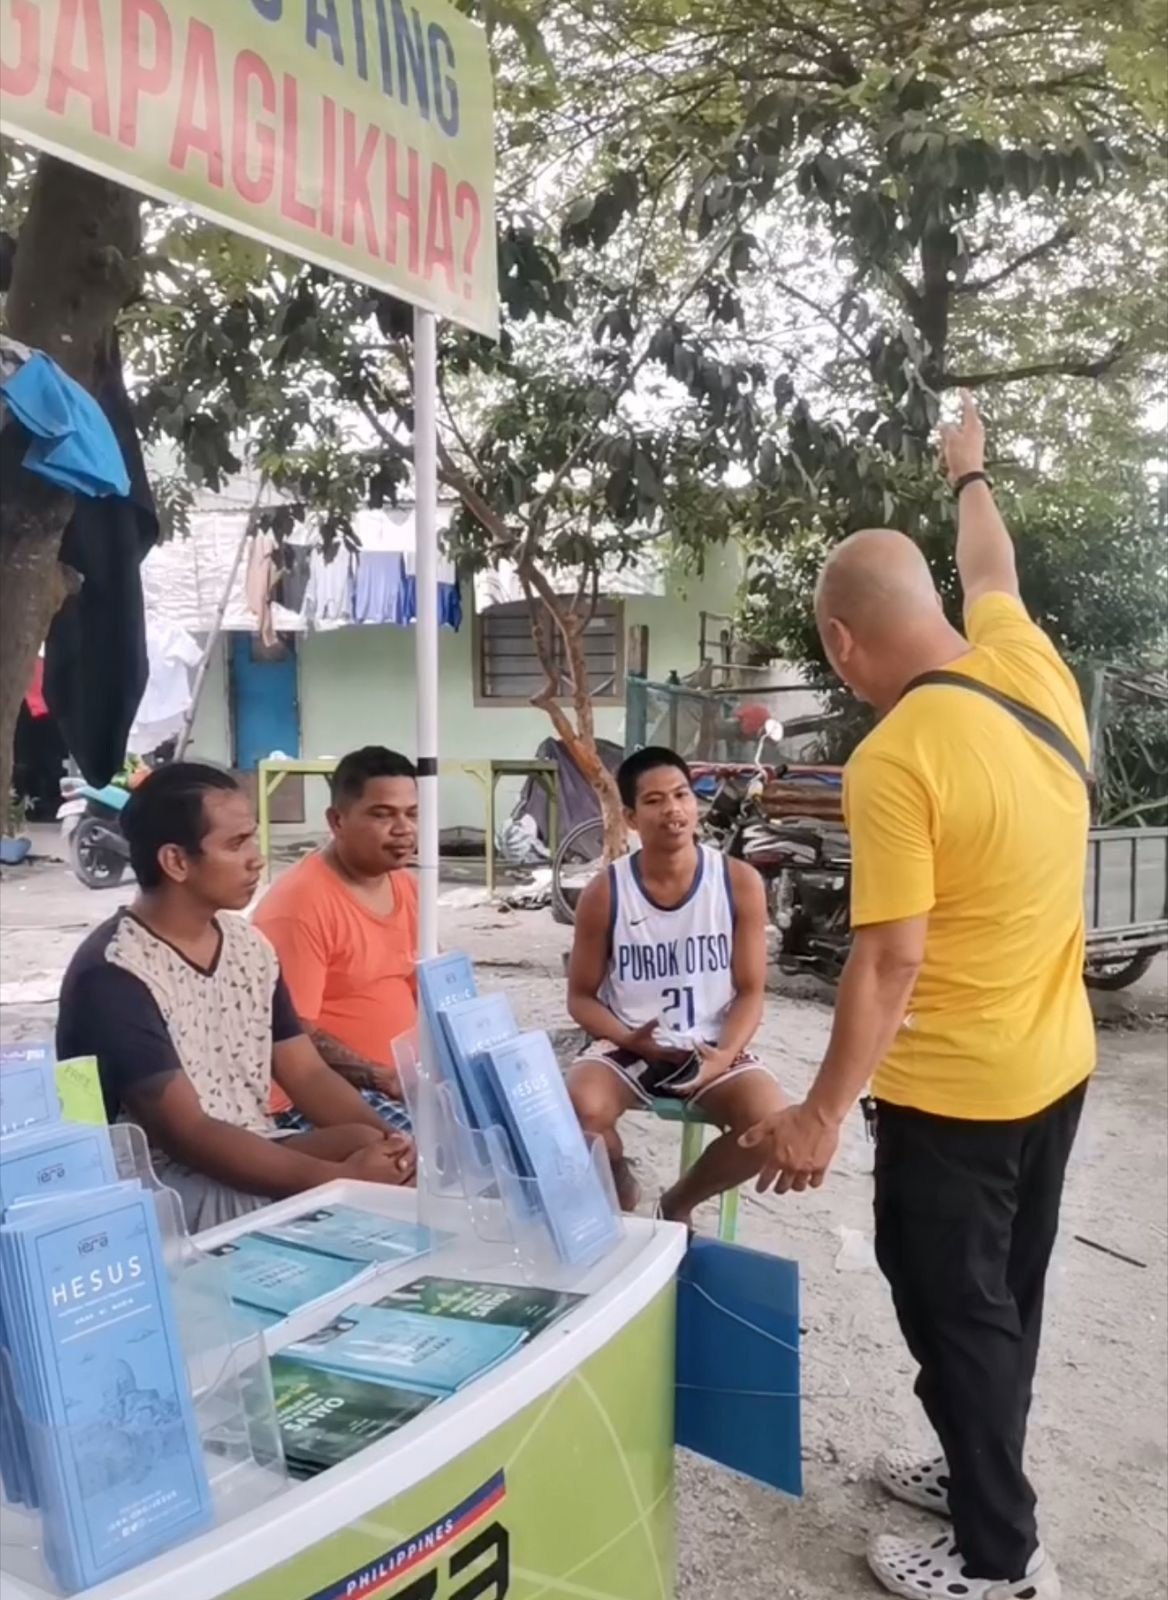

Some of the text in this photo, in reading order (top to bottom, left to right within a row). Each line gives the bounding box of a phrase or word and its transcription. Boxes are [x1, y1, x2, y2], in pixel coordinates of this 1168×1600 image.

[619, 932, 728, 981] PUROK OTSO
[661, 986, 695, 1031] 21
[51, 1255, 142, 1307] HESUS
[346, 1518, 454, 1596] PHILIPPINES
